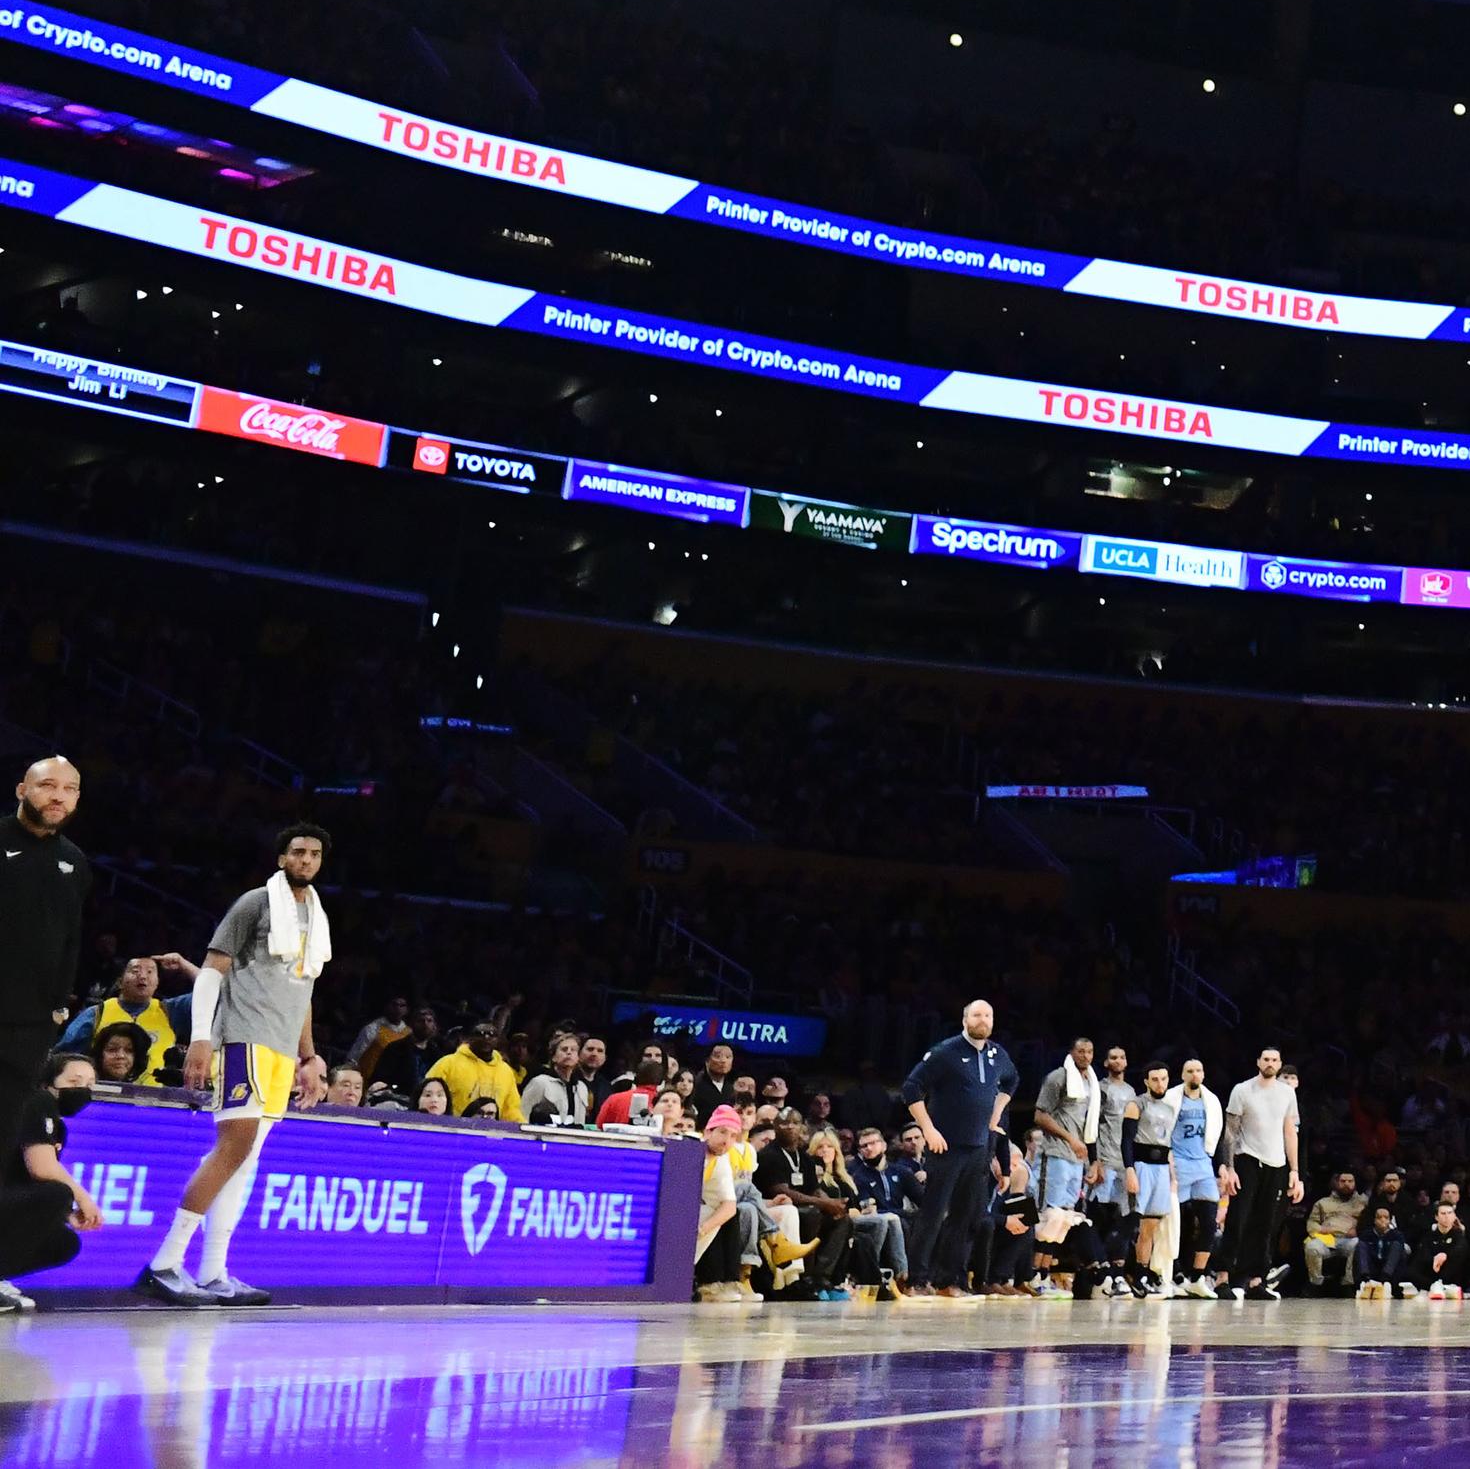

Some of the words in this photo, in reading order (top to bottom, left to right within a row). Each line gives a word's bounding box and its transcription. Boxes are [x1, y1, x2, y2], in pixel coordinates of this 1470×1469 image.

[379, 113, 565, 184] TOSHIBA
[707, 196, 768, 224] Printer
[772, 211, 848, 241] Provider
[852, 231, 871, 247] of
[874, 234, 984, 267] Crypto.com
[989, 254, 1045, 276] Arena
[200, 218, 395, 295] TOSHIBA
[1176, 278, 1339, 324] TOSHIBA
[1039, 390, 1212, 437] TOSHIBA
[1339, 434, 1397, 453] Printer
[454, 451, 536, 482] TOYOTA
[579, 473, 664, 502] AMERICAN
[665, 488, 737, 513] EXPRESS
[932, 521, 1058, 561] Spectrum
[1100, 547, 1151, 571] UCLA
[1164, 552, 1233, 580] Health
[1288, 568, 1387, 592] crypto.com
[722, 1022, 790, 1044] ULTRA
[1183, 1124, 1205, 1139] 24
[258, 1173, 429, 1233] FANDUEL
[507, 1187, 638, 1241] FANDUEL
